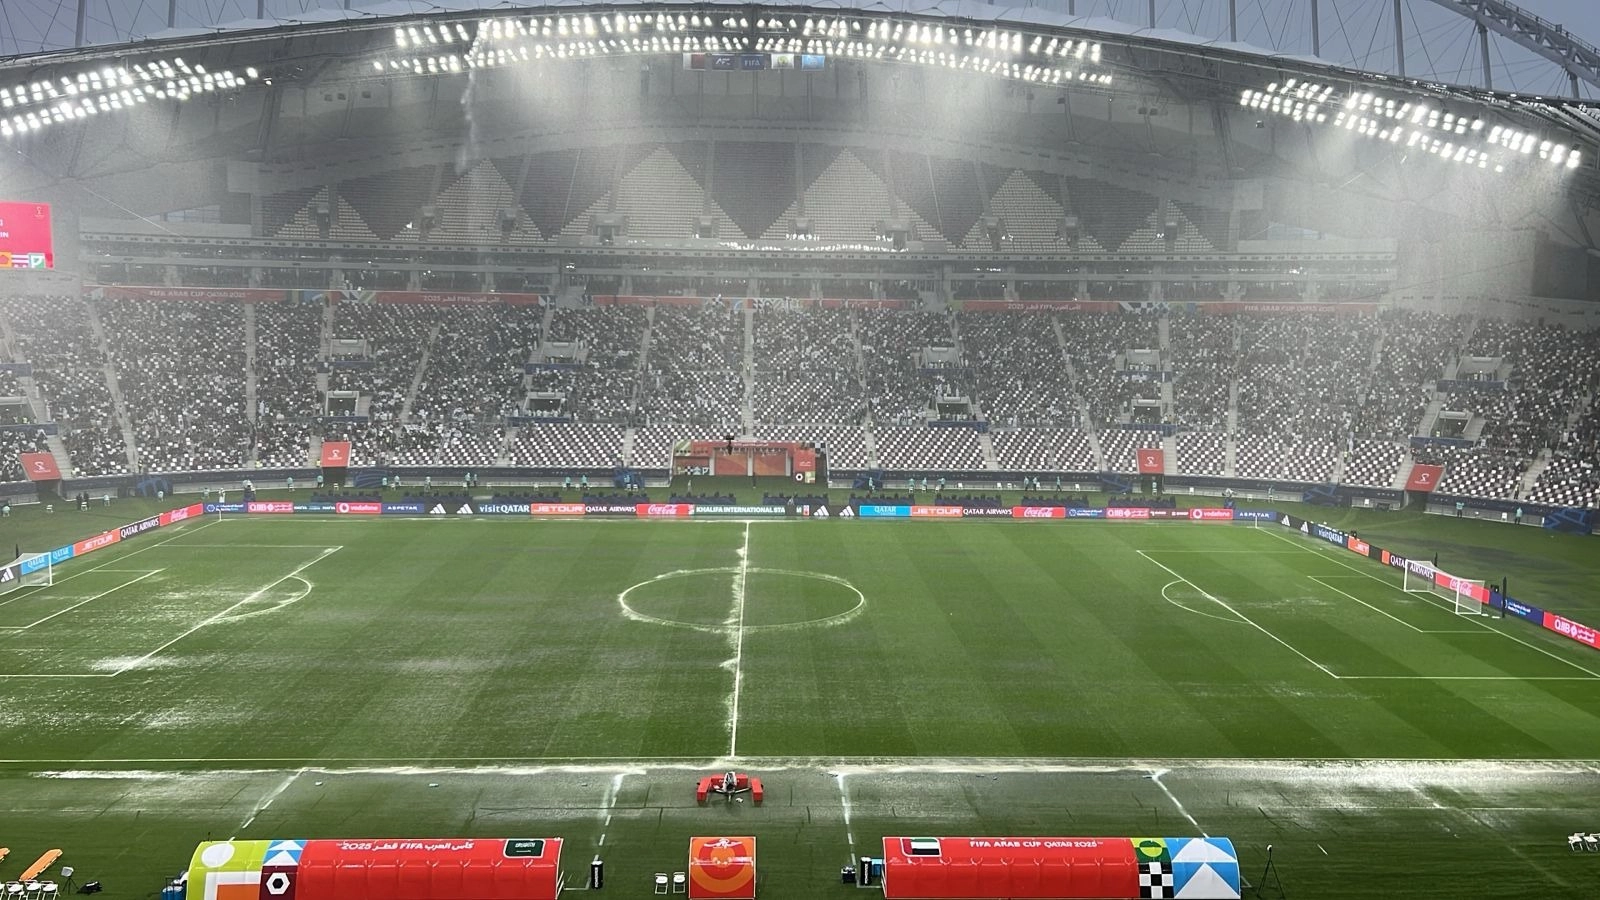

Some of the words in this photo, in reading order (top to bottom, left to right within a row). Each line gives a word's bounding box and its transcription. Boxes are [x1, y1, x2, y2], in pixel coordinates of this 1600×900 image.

[586, 505, 607, 513] QATAR
[120, 525, 138, 538] QATAR
[139, 518, 159, 530] AIRWAYS
[82, 534, 112, 550] JETOUR
[52, 547, 69, 560] QATAR
[1410, 564, 1434, 580] AIRWAYS
